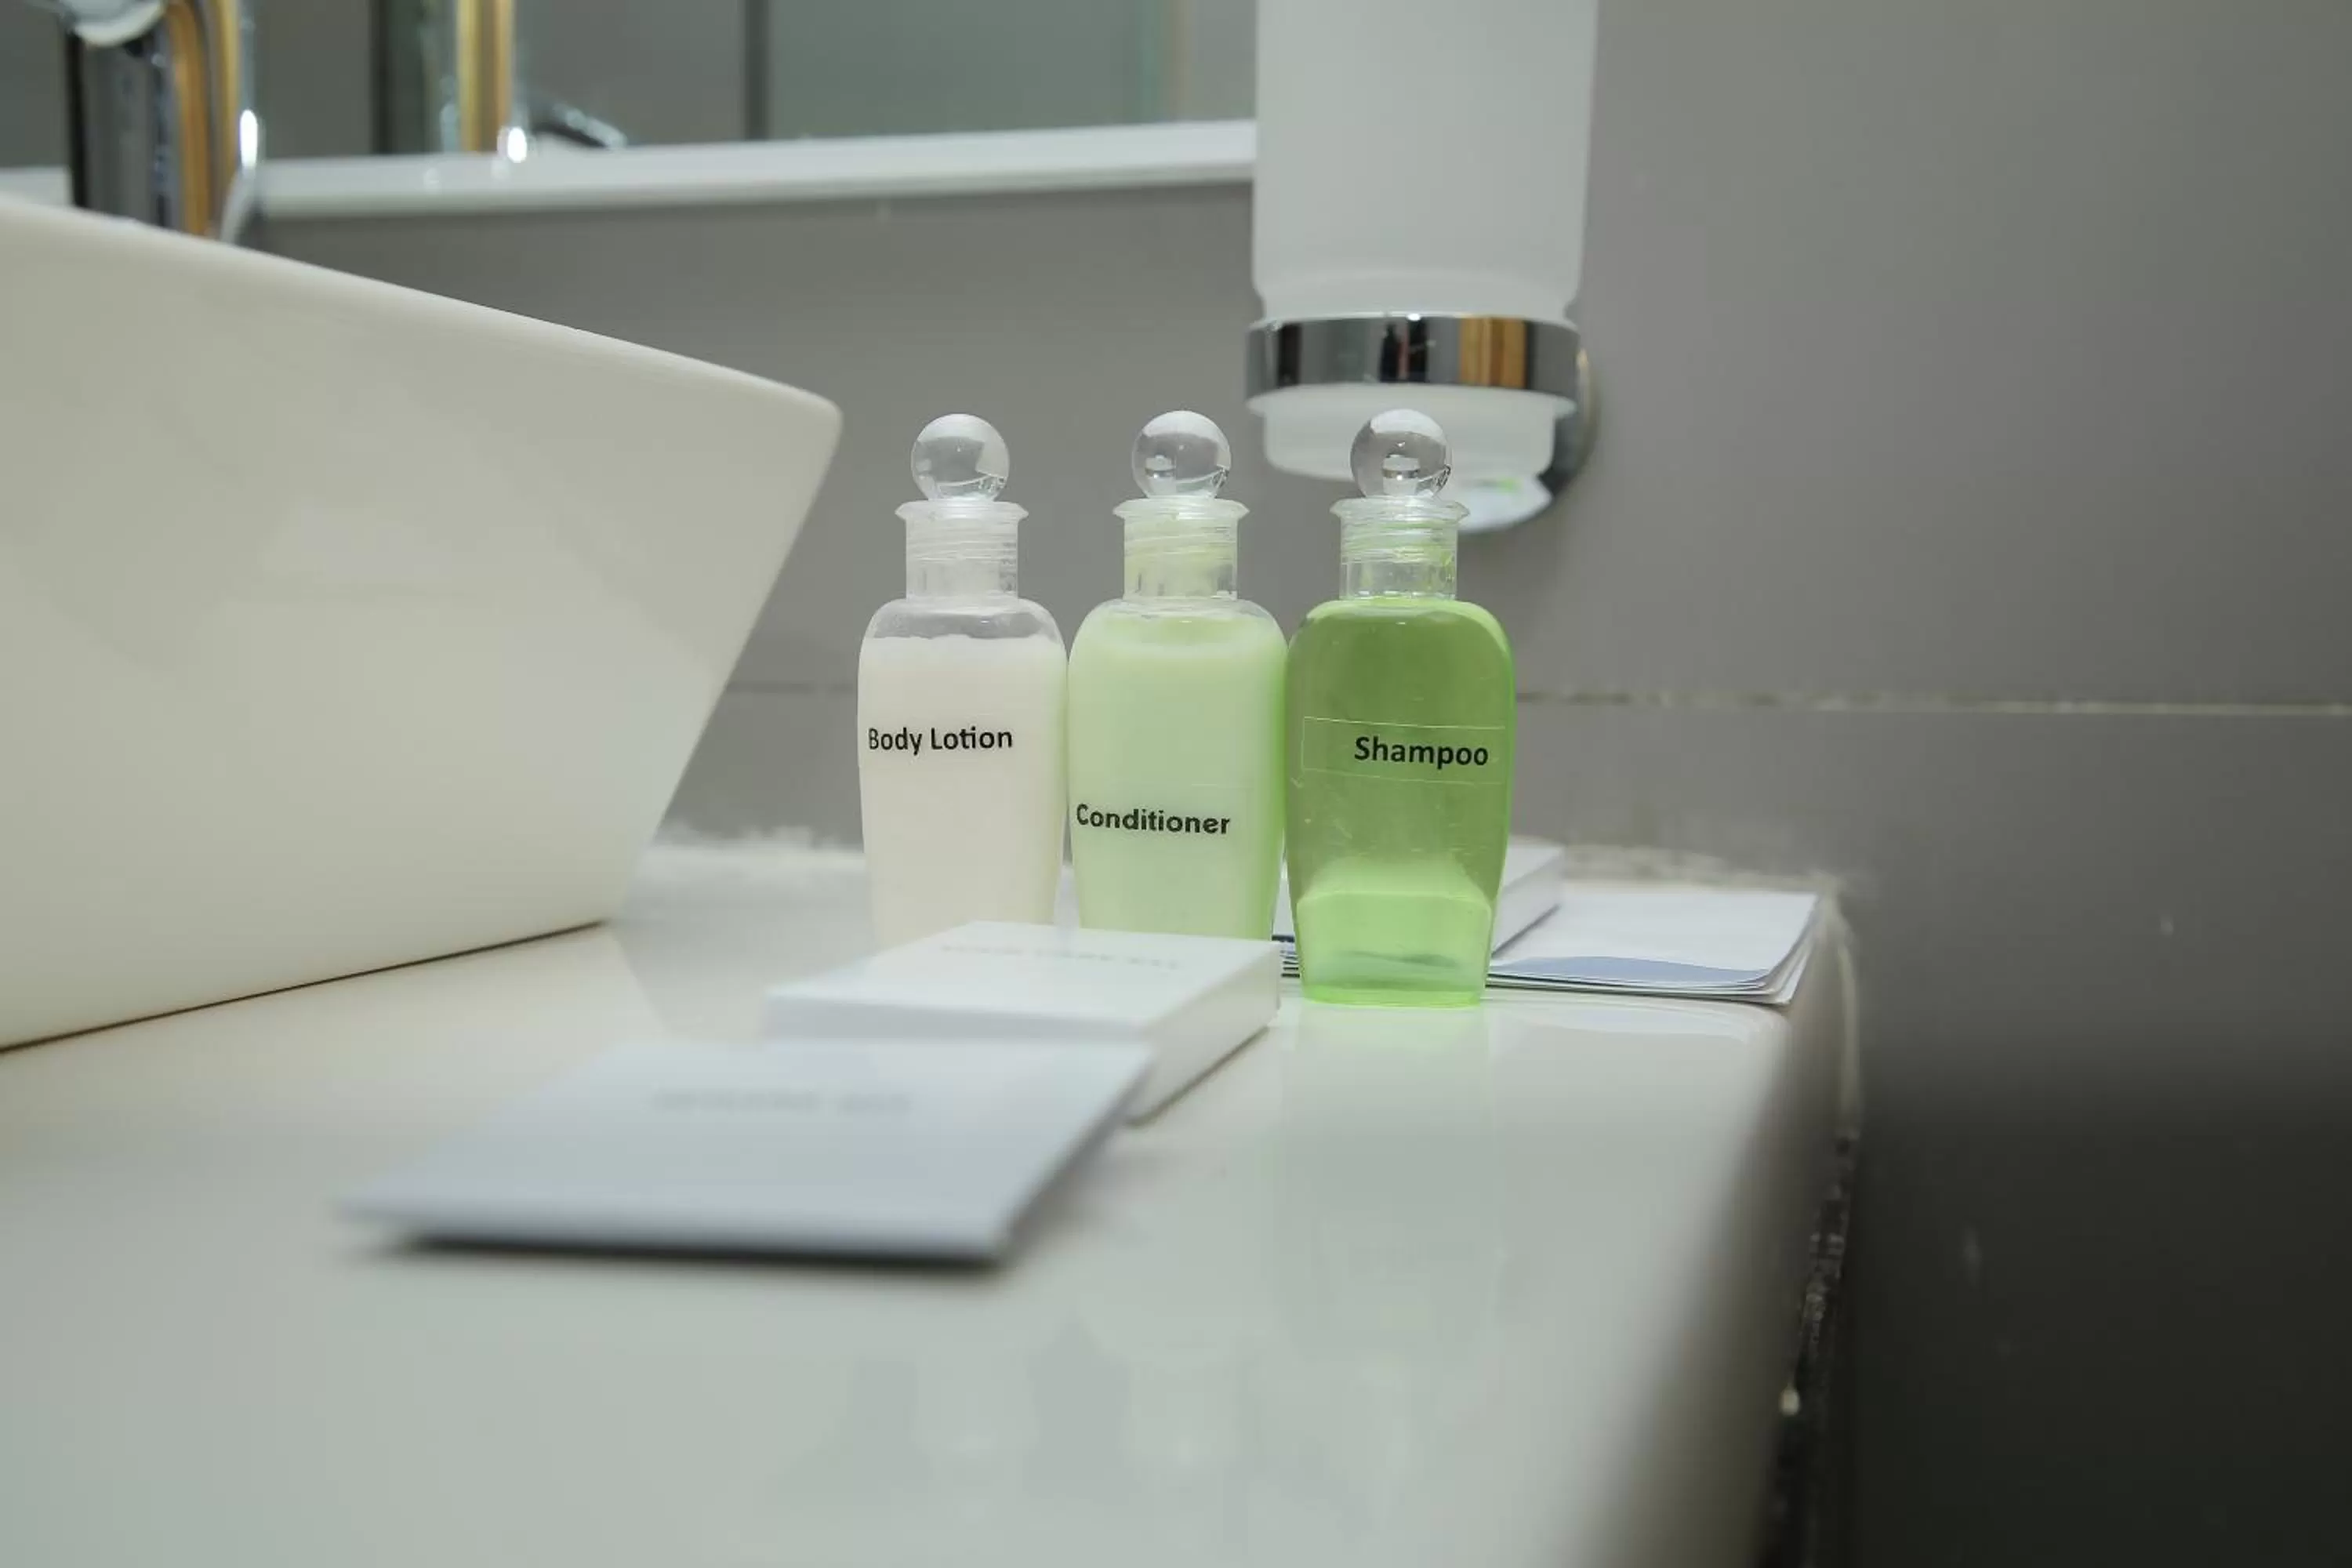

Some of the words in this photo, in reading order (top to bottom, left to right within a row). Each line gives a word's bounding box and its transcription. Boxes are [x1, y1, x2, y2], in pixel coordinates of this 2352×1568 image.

[868, 726, 923, 756] Body
[931, 726, 1012, 750] Lotion
[1354, 735, 1489, 770] Shampoo
[1076, 803, 1230, 834] Conditioner
